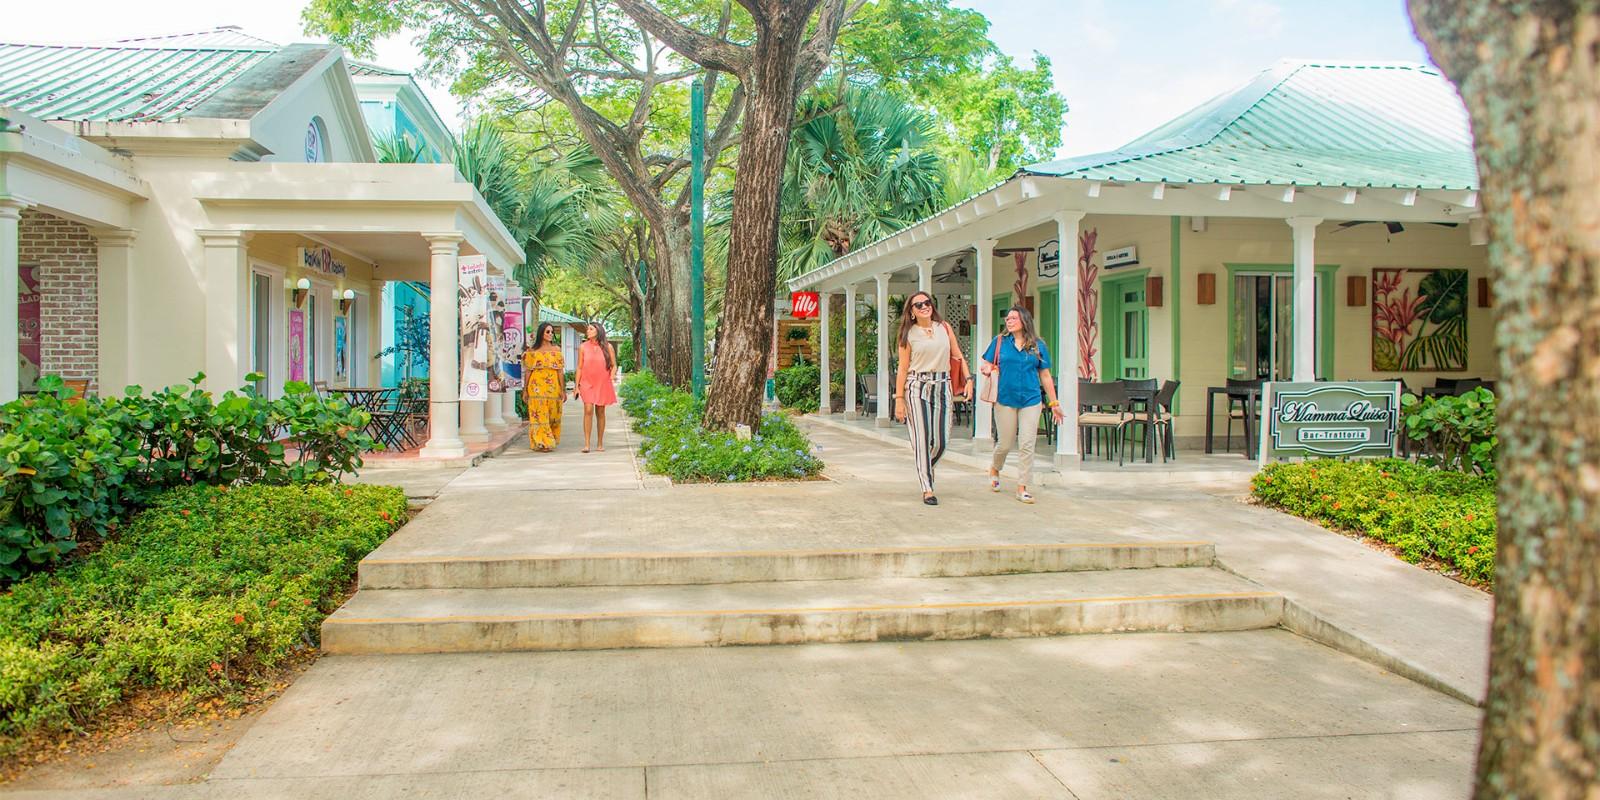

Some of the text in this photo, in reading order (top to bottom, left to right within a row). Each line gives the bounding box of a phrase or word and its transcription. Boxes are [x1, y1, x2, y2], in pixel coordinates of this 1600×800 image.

[794, 294, 817, 316] illy
[1280, 400, 1388, 422] Mamma Luisa
[1303, 431, 1365, 439] Bar-Trattoria
